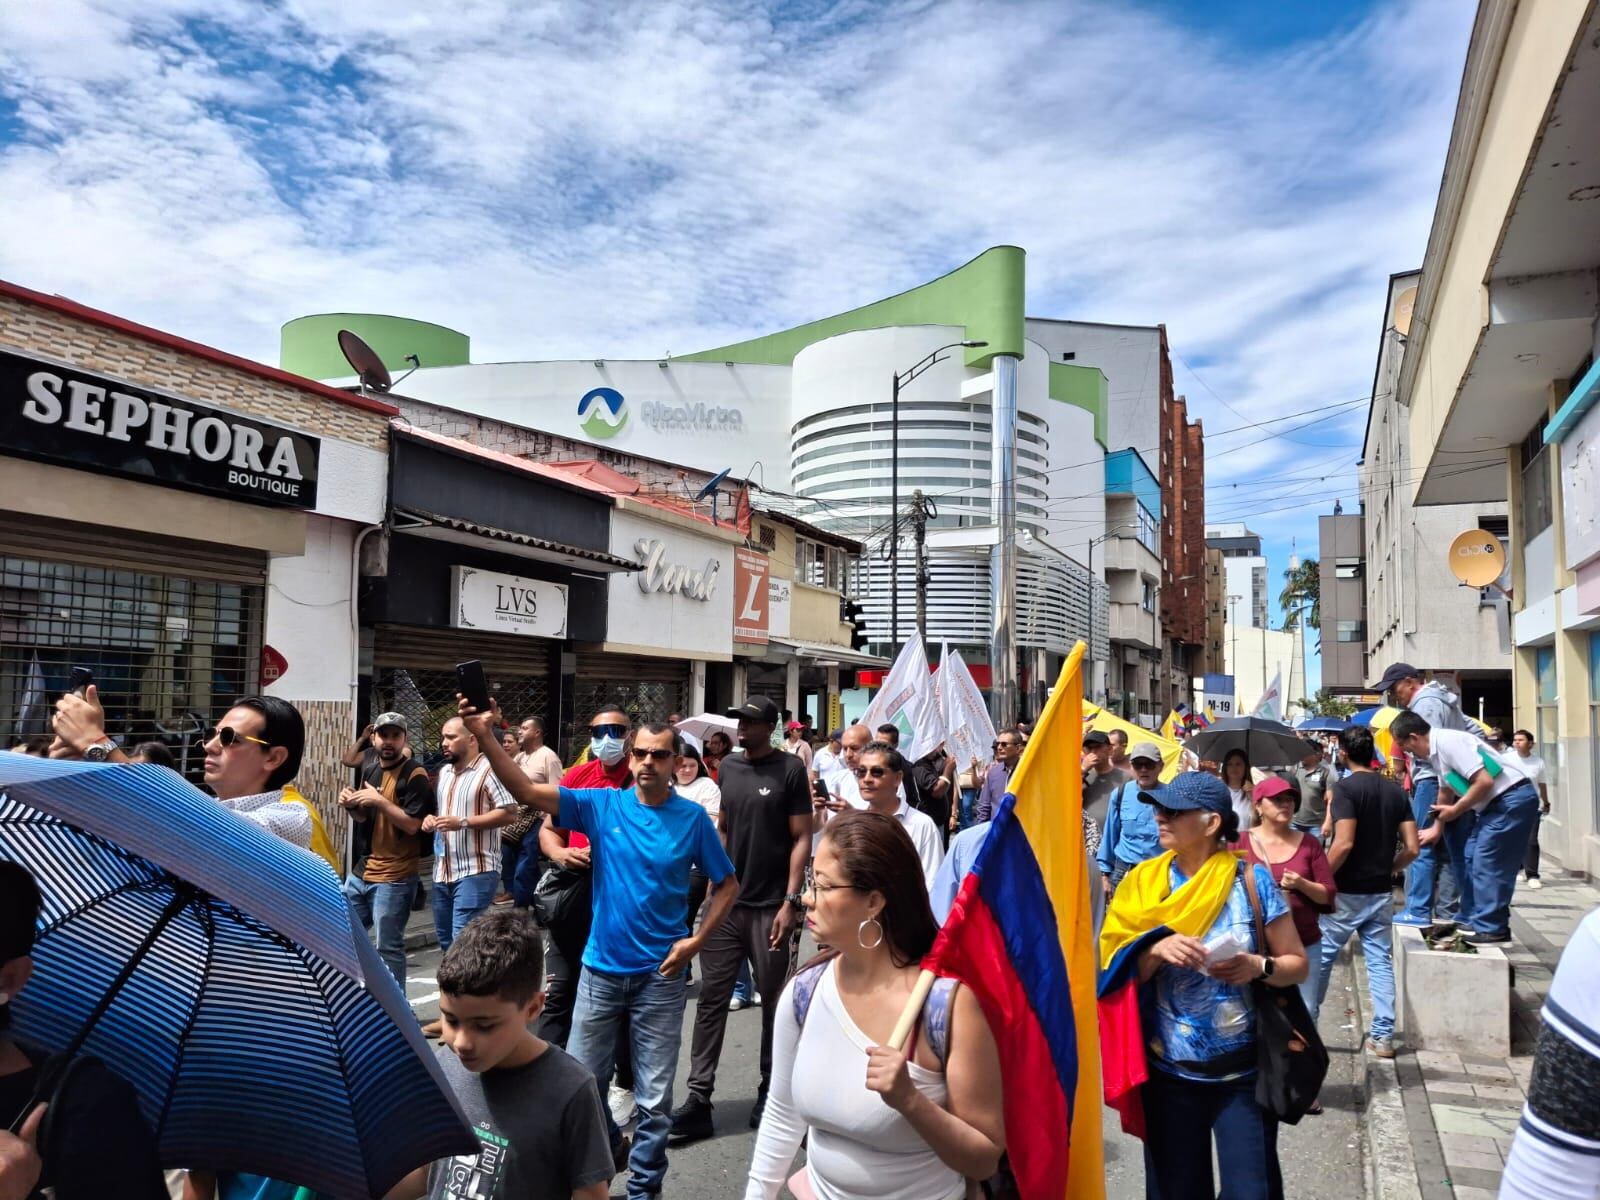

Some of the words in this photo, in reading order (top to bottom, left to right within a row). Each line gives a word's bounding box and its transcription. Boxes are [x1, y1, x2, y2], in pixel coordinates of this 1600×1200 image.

[22, 371, 304, 481] SEPHORA
[228, 470, 300, 497] BOUTIQUE
[496, 584, 537, 615] LVS
[1208, 699, 1231, 712] M-19
